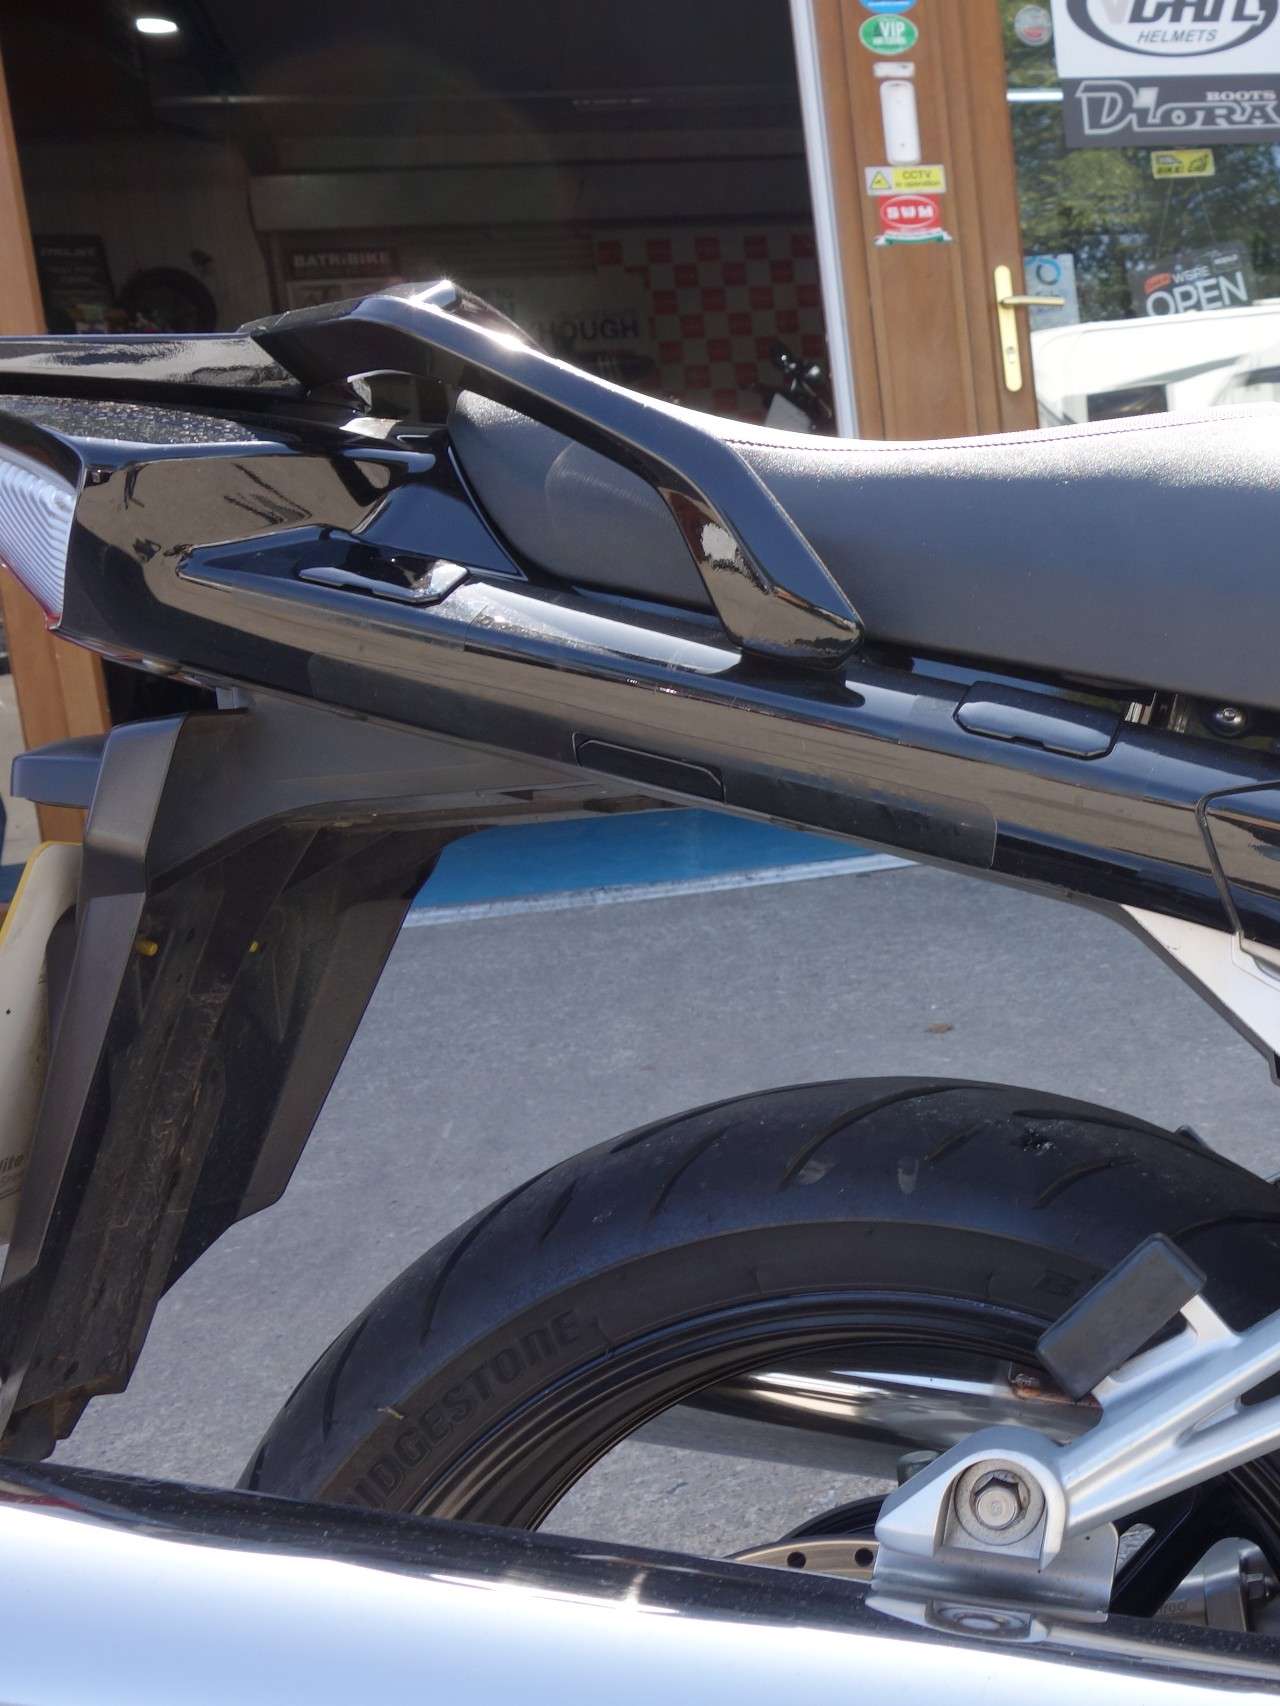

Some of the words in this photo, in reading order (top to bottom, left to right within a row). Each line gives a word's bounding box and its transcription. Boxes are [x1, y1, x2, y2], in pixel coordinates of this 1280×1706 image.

[879, 20, 906, 37] VIP
[1137, 29, 1218, 44] HELMETS
[1205, 90, 1277, 103] BOOTS
[902, 169, 933, 180] CCTV
[1145, 270, 1249, 317] OPEN
[350, 1308, 582, 1508] IDGESTONE
